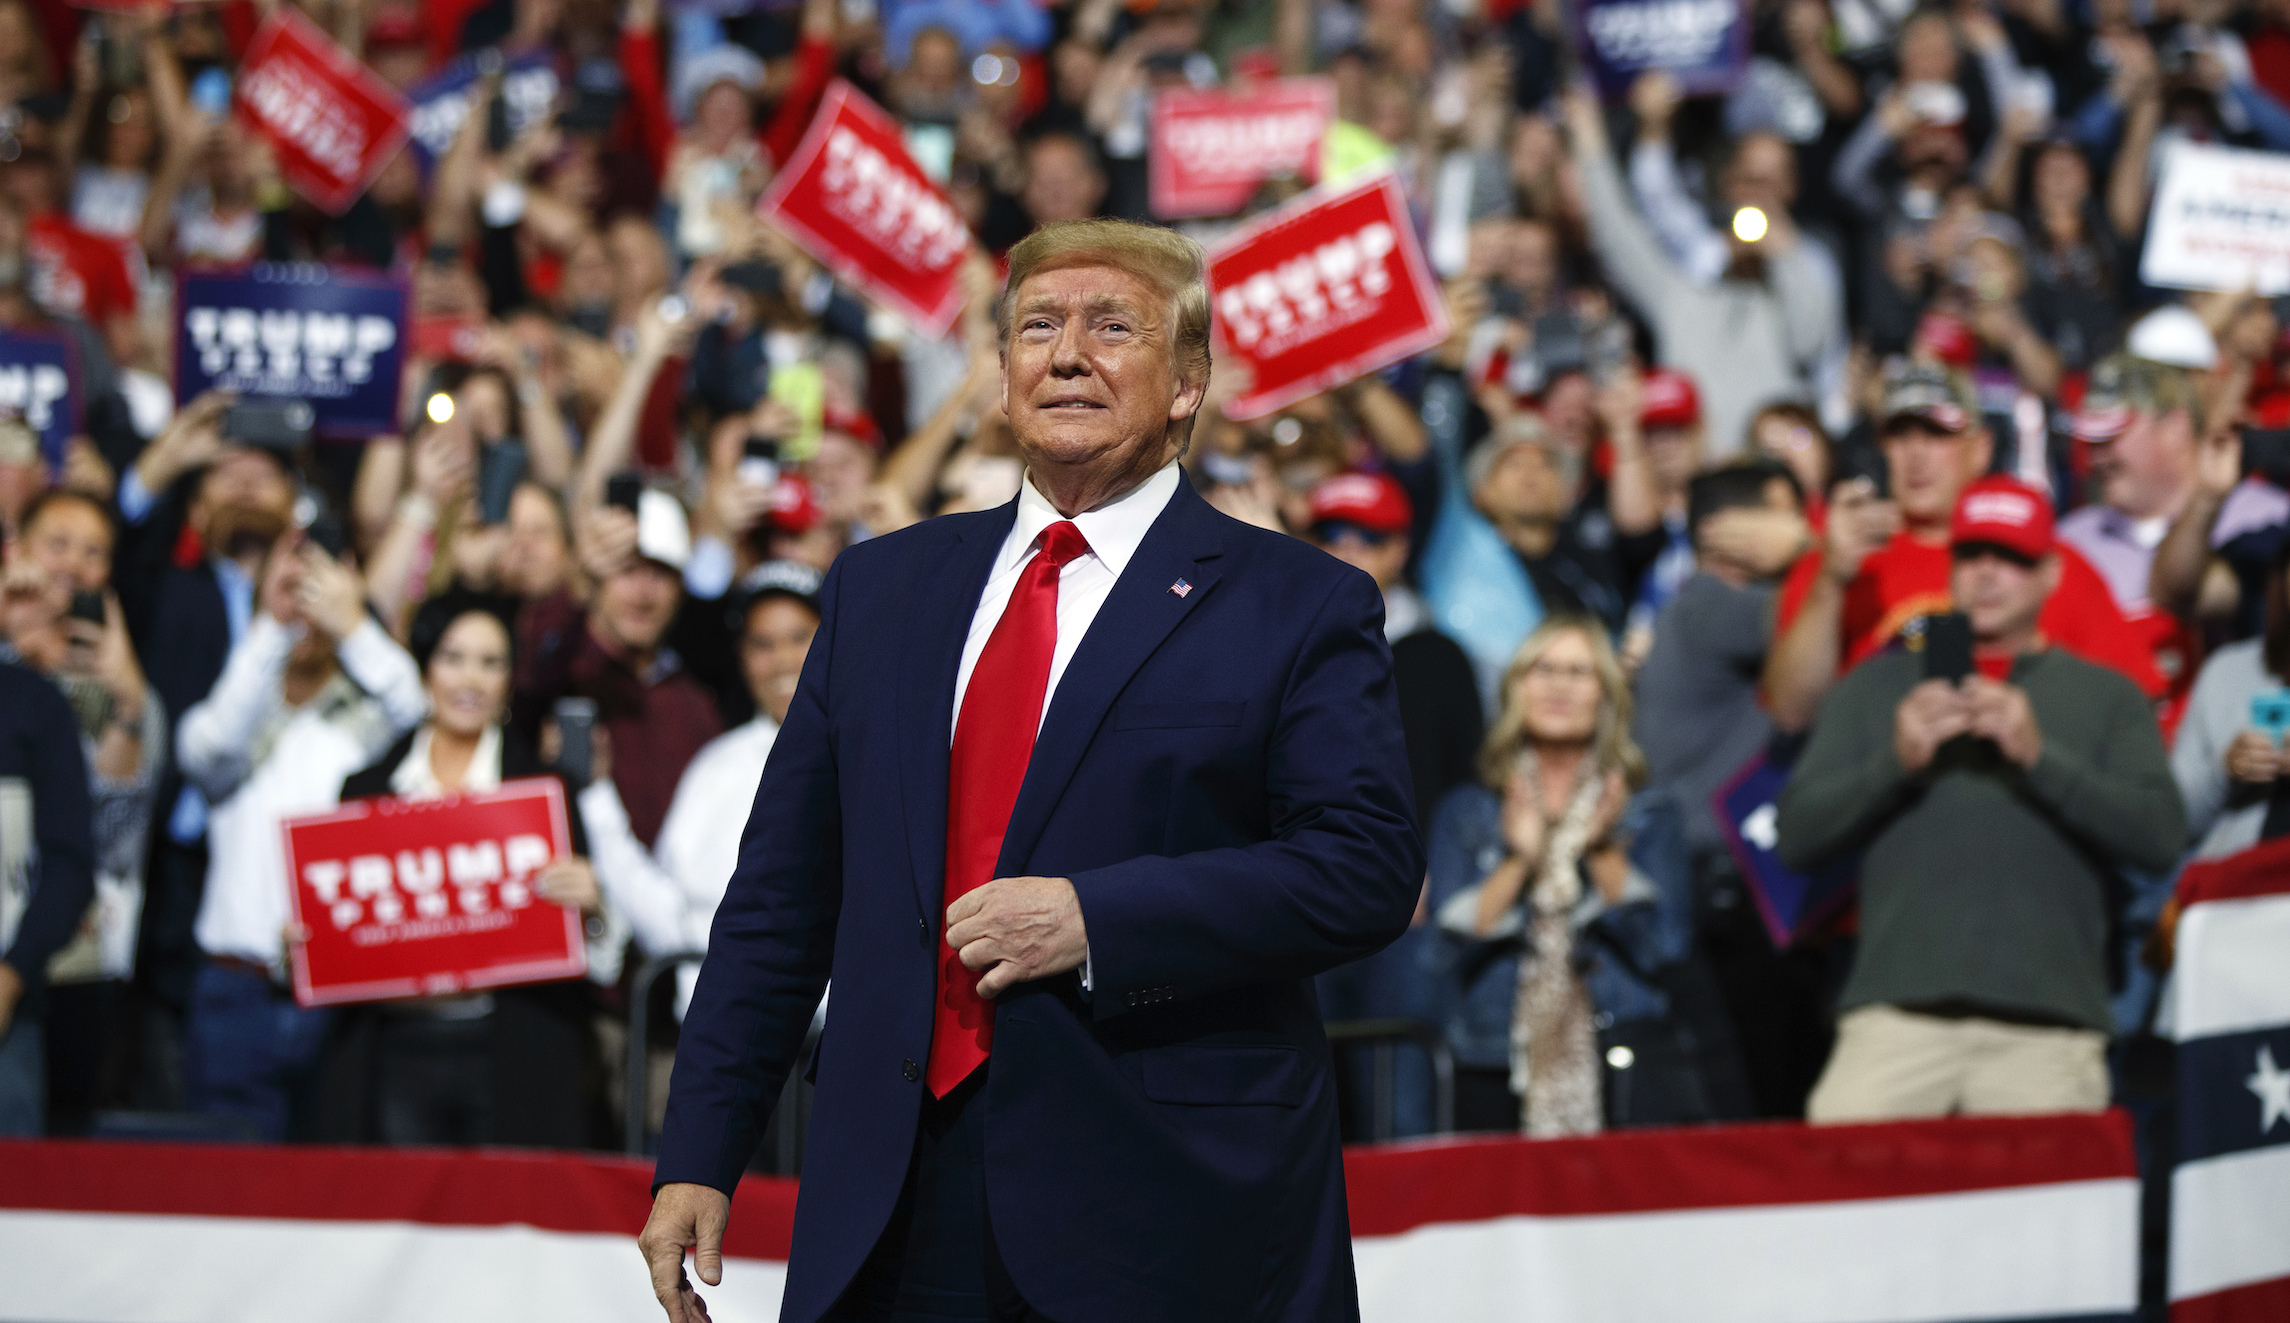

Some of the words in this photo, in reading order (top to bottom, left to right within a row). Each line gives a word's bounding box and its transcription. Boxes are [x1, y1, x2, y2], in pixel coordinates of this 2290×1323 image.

[1219, 221, 1396, 324] TRUMP
[187, 307, 396, 355] TRUMP
[304, 834, 550, 904] TRUMP
[331, 878, 532, 932] PENCE
